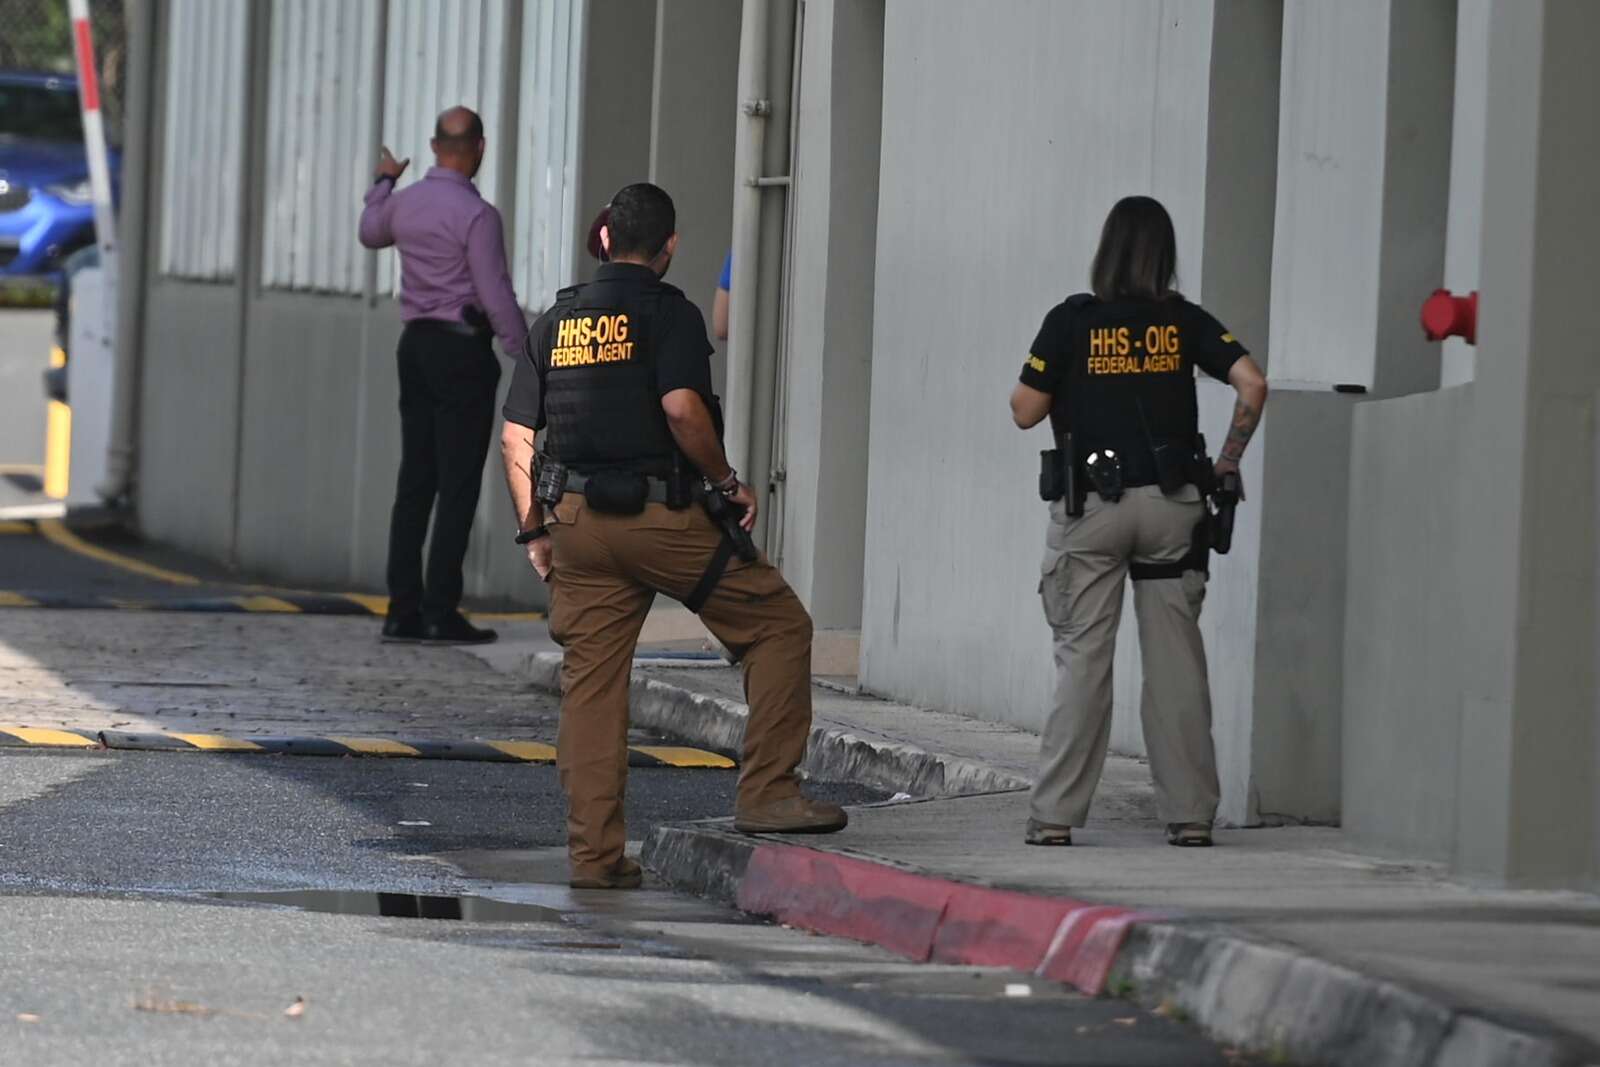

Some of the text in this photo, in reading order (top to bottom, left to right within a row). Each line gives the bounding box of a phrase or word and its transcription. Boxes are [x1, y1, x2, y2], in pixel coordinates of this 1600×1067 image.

[557, 314, 628, 347] HHS-OIG
[550, 342, 633, 367] FEDERAL AGENT
[1087, 354, 1181, 375] FEDERAL AGENT
